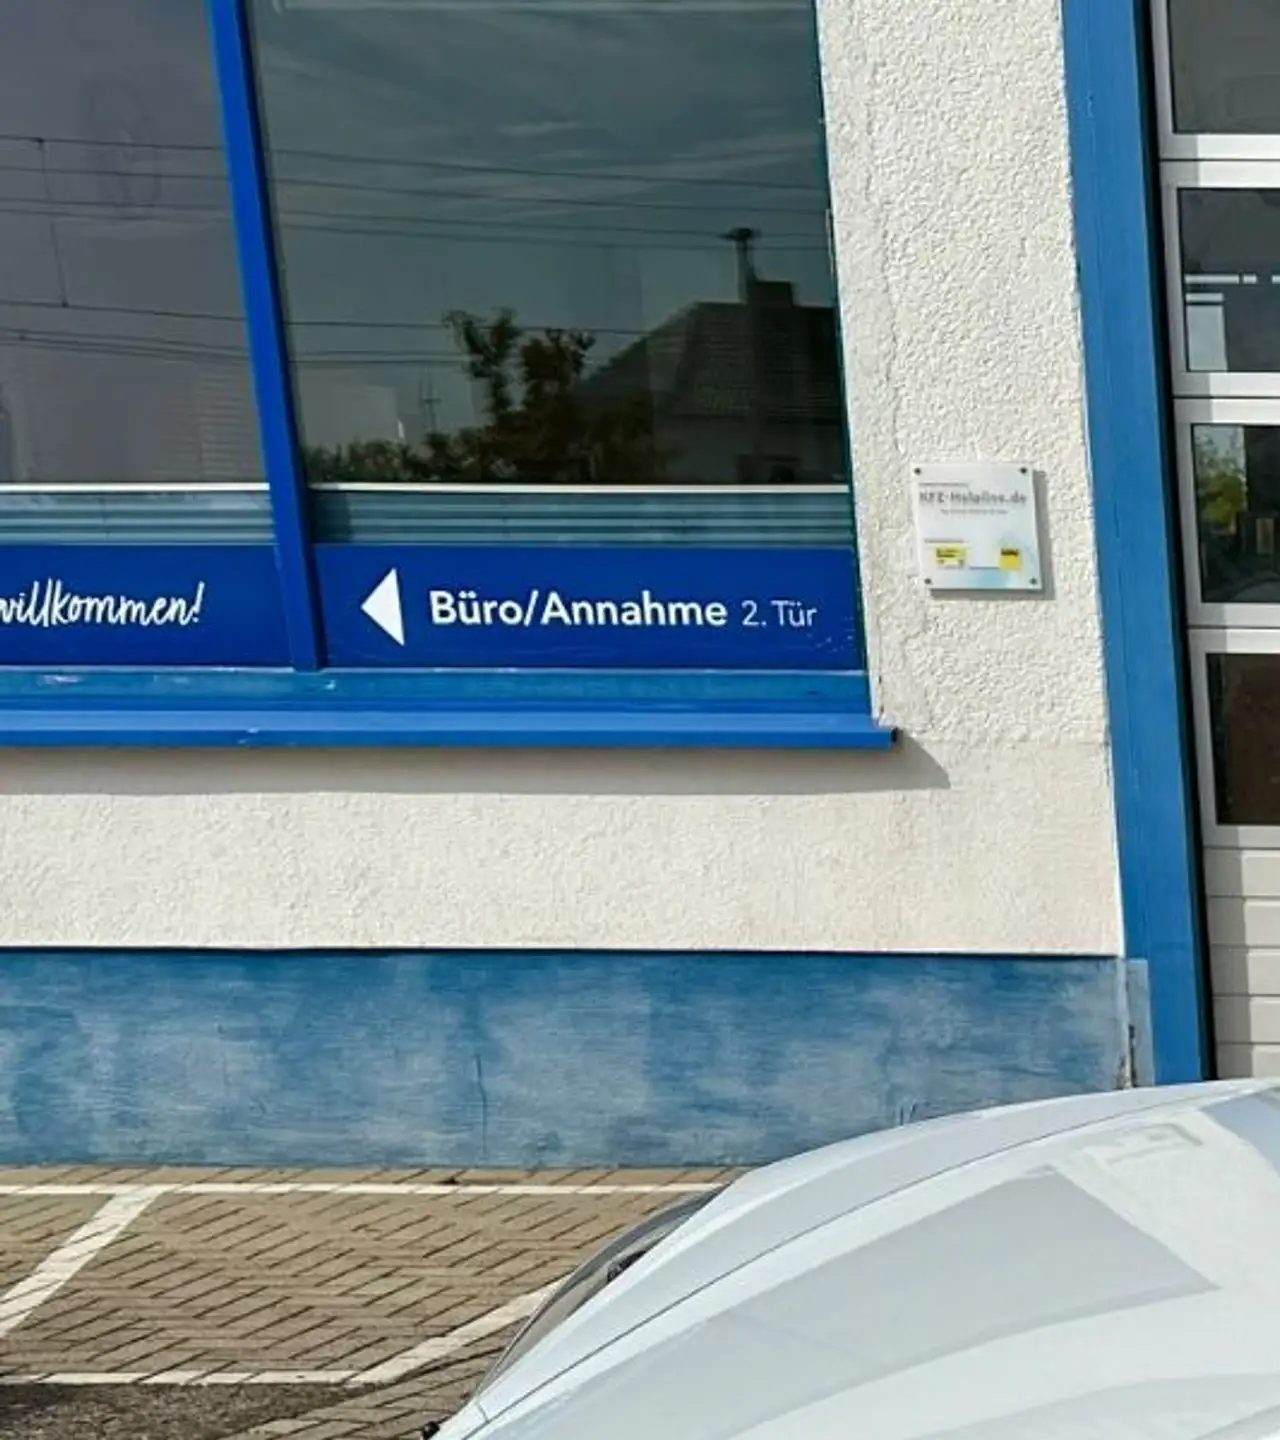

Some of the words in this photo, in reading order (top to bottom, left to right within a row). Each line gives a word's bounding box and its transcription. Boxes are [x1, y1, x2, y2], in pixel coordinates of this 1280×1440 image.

[429, 589, 728, 627] Büro/Annahme
[741, 601, 768, 627] 2.
[772, 600, 816, 627] Tür
